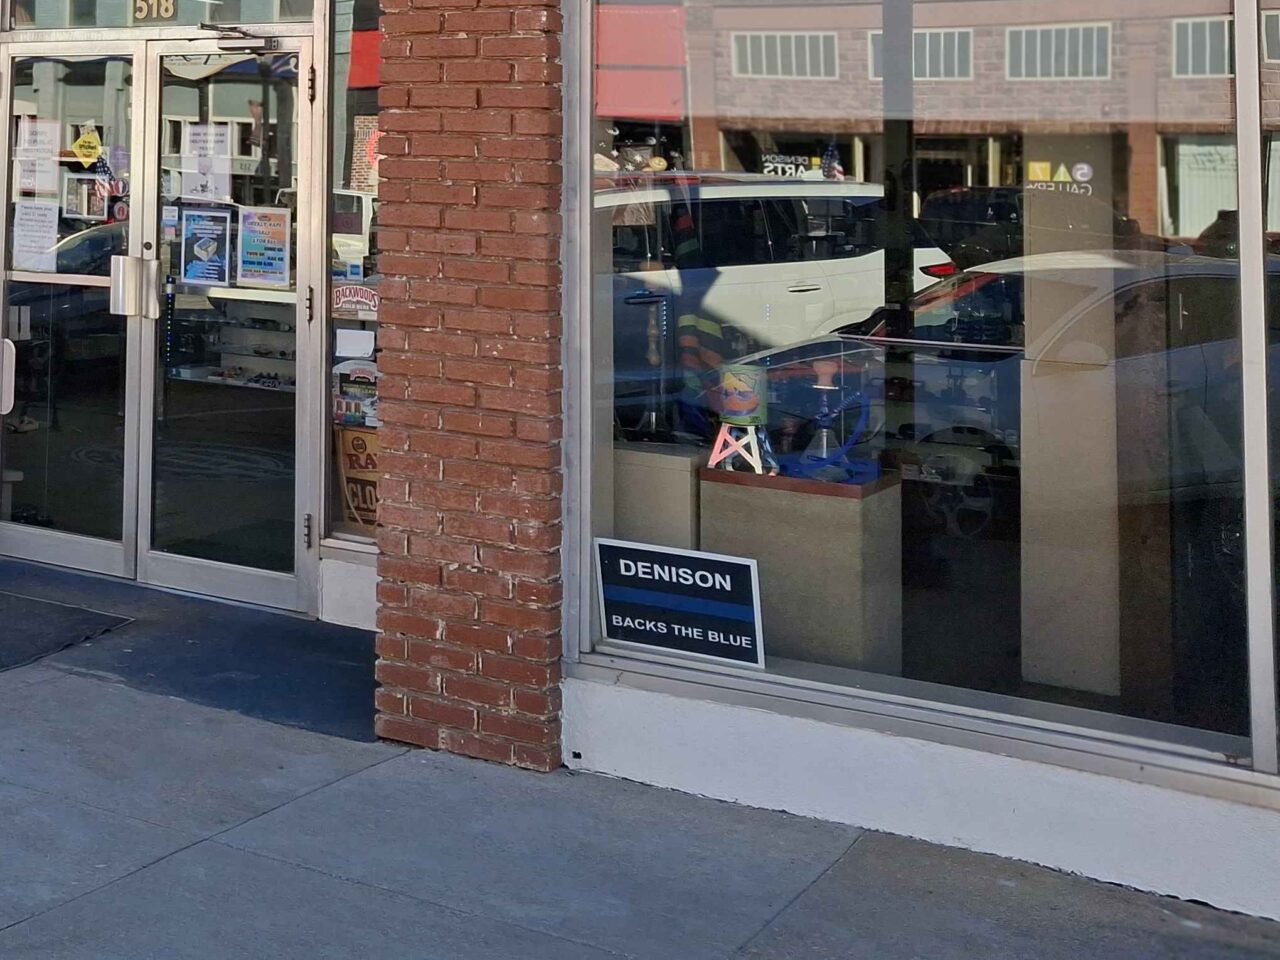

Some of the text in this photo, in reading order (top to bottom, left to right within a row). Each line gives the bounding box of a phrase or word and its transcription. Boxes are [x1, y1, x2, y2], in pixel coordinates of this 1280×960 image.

[334, 286, 377, 310] BACKWOODS
[346, 453, 377, 470] RA
[620, 559, 732, 592] DENISON
[612, 615, 753, 649] BACKS THE BLUE
